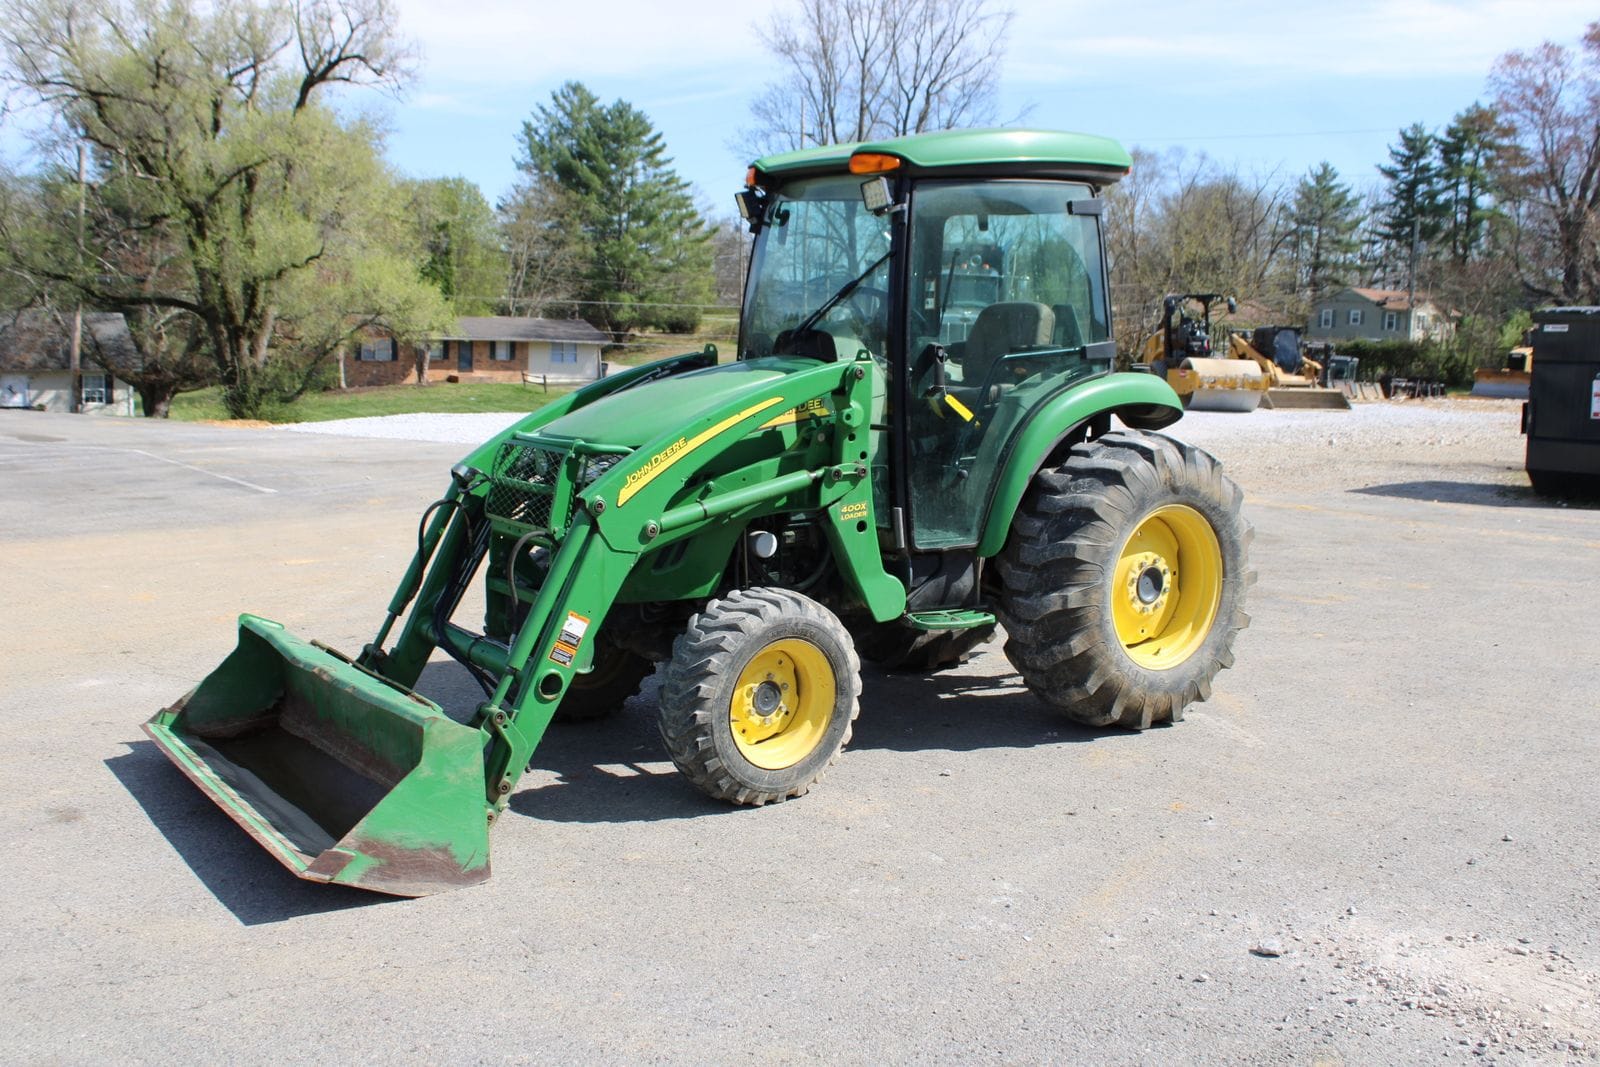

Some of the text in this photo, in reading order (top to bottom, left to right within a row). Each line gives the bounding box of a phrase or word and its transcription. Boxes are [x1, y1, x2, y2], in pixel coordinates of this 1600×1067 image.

[624, 436, 688, 489] JOHN DEERE
[841, 503, 867, 513] 400X
[841, 511, 868, 521] LOADER
